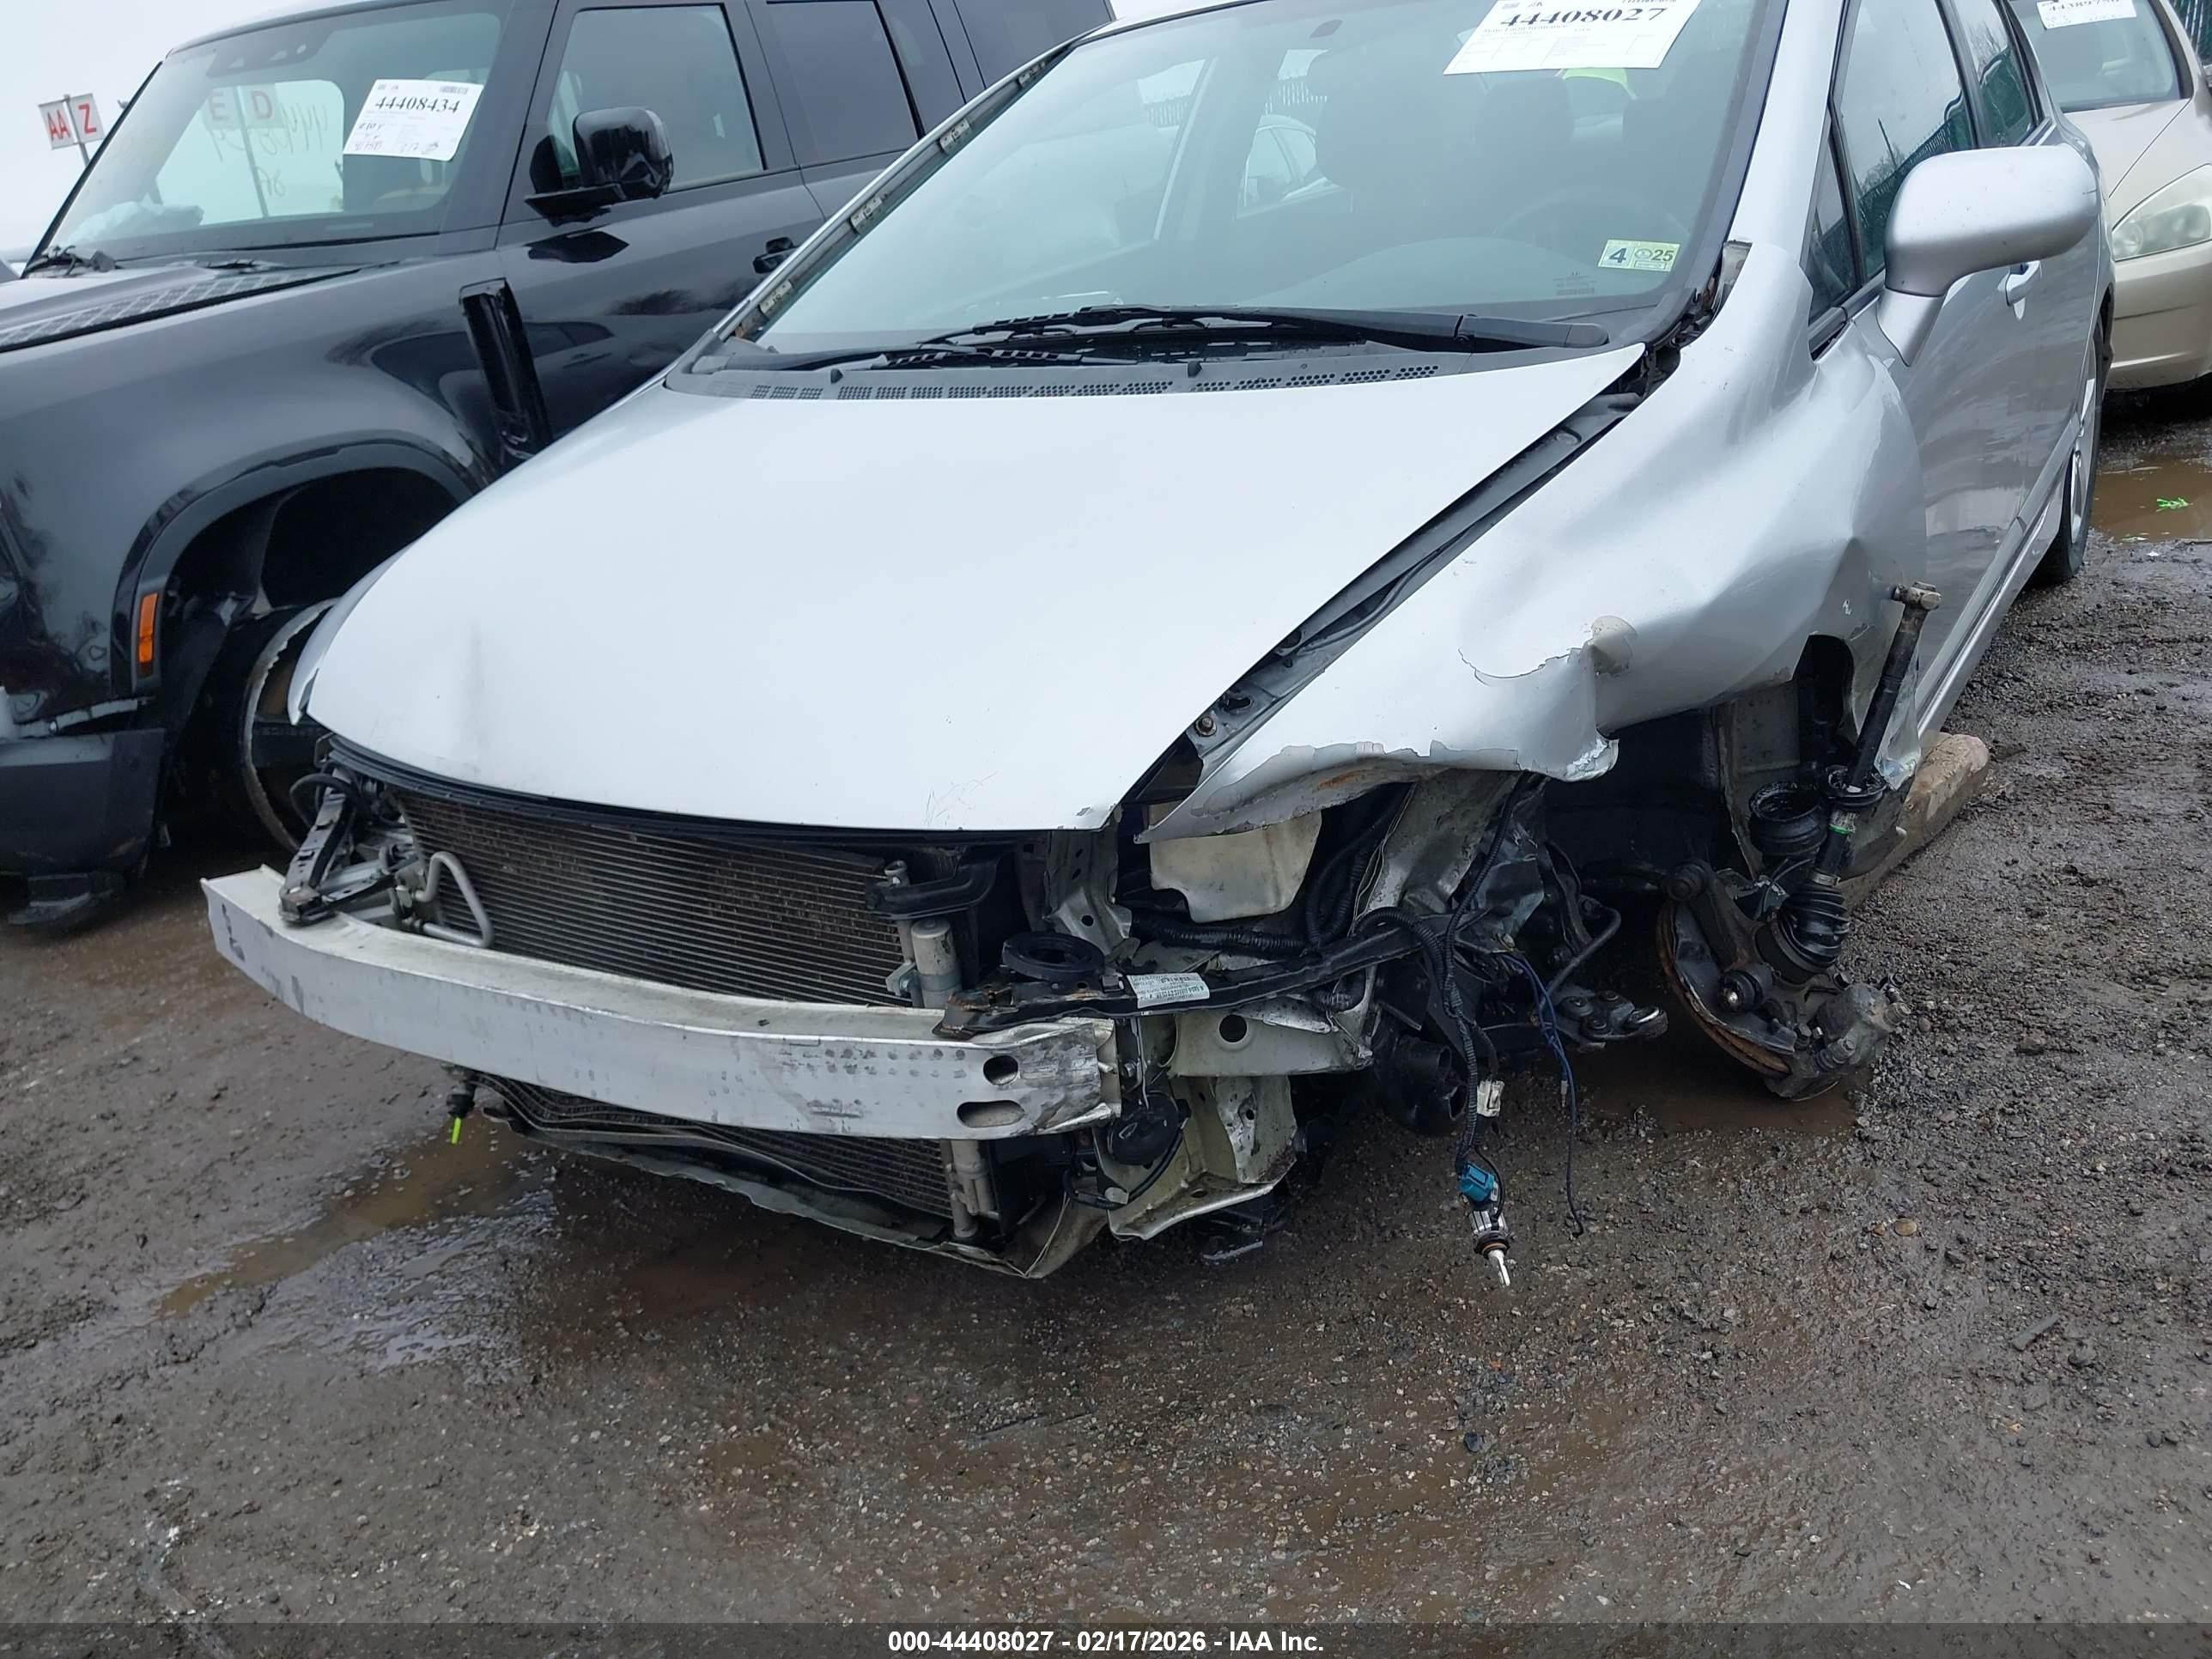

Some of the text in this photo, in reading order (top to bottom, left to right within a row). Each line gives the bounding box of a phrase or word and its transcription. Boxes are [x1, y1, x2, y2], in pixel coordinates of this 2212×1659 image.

[1500, 8, 1668, 27] 44408027
[250, 89, 274, 120] D
[375, 96, 460, 113] 44408434
[47, 109, 70, 142] AA
[78, 102, 97, 134] Z
[1608, 247, 1674, 264] 4 25
